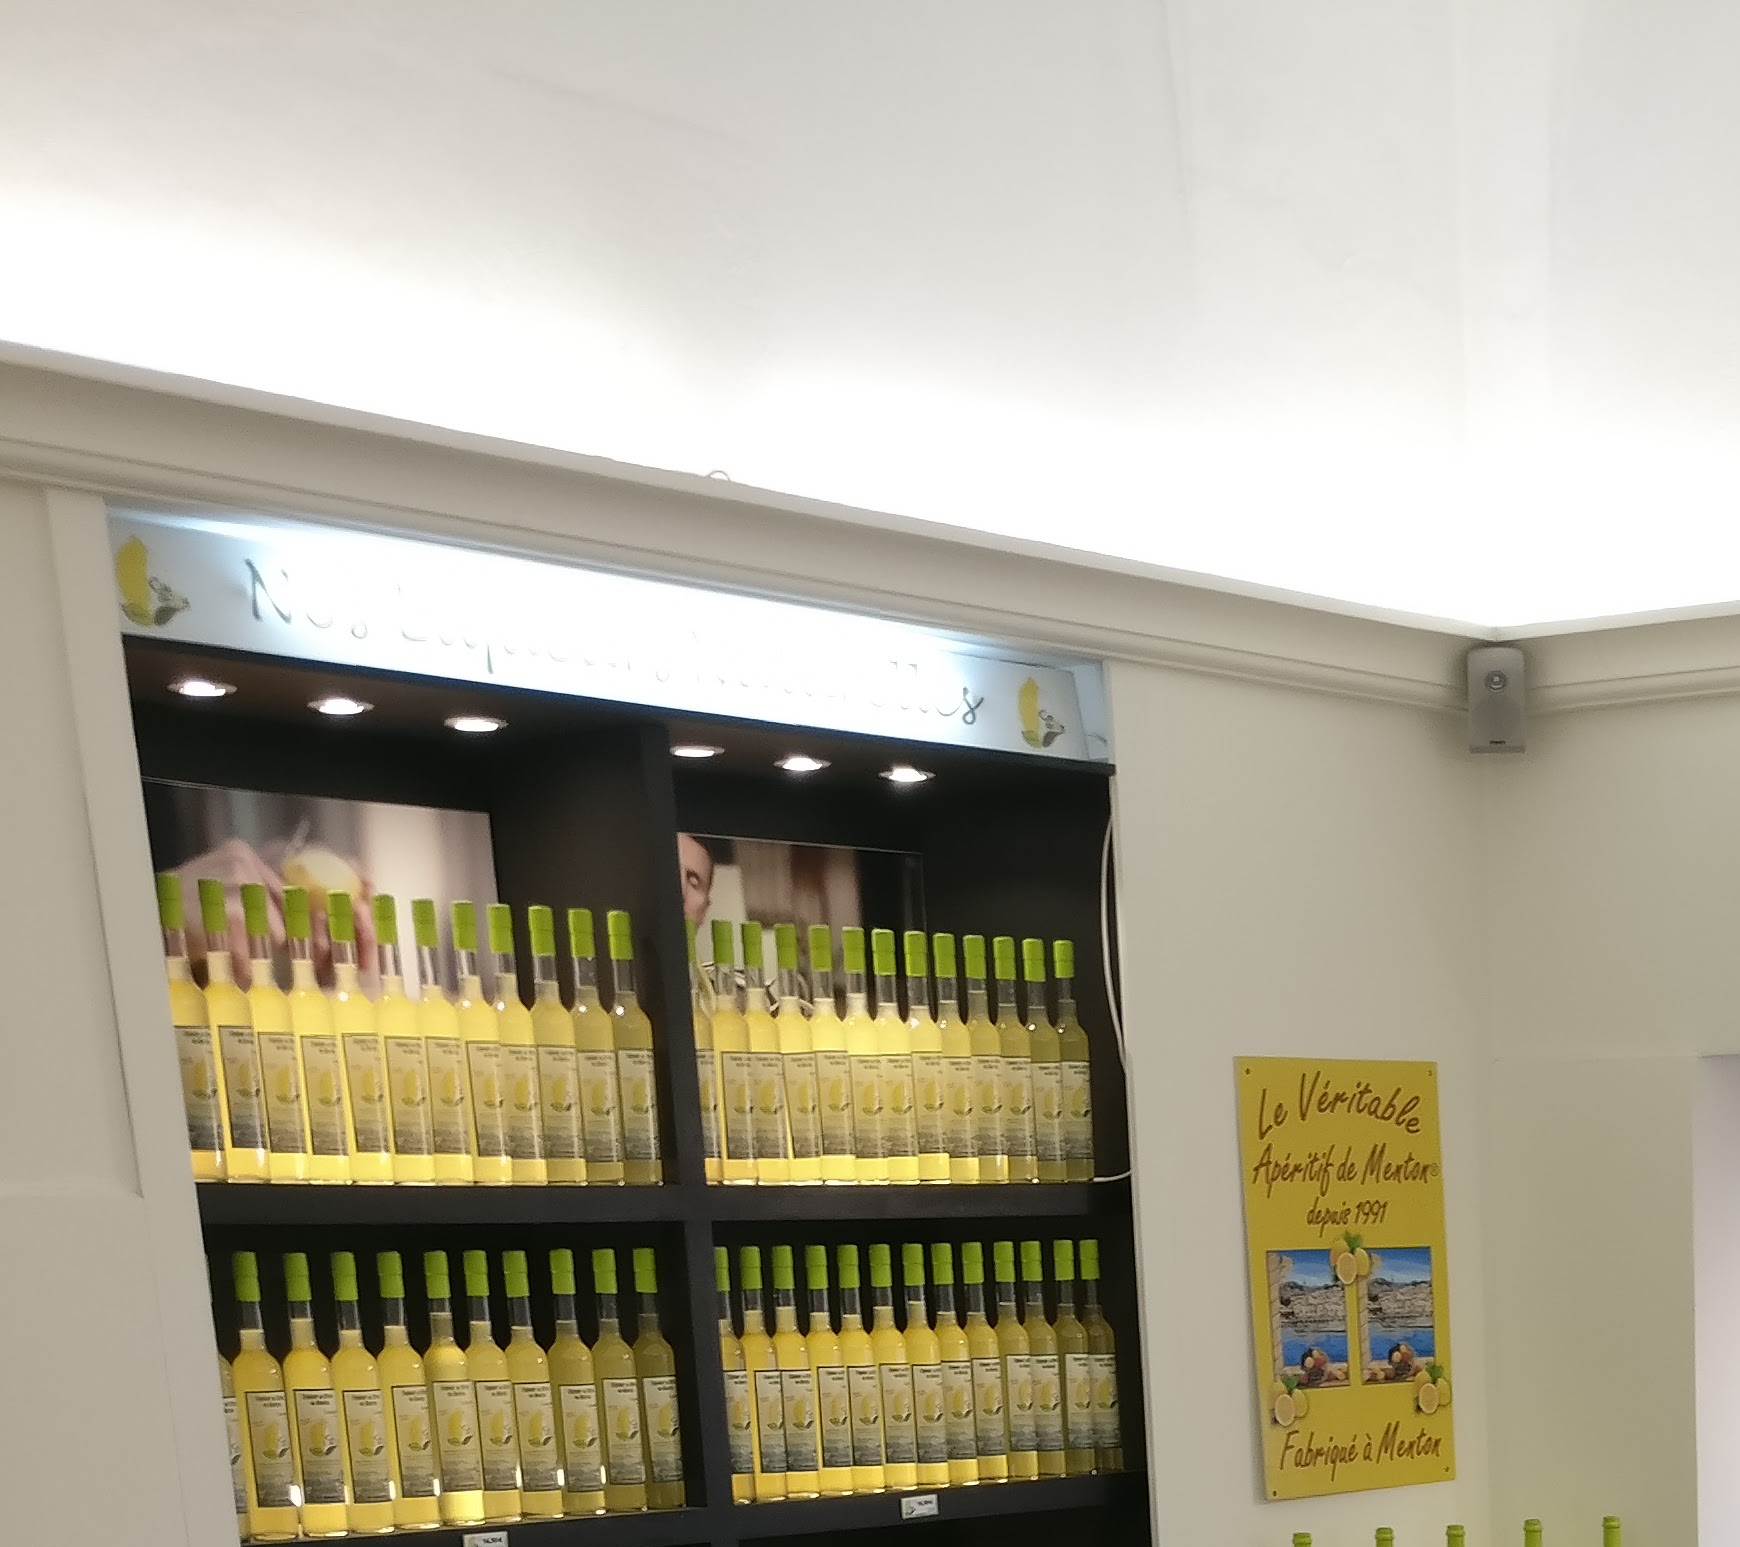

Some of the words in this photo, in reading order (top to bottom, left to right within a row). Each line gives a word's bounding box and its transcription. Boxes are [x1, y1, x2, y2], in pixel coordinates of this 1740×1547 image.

[1258, 1088, 1288, 1140] Le
[1299, 1071, 1422, 1135] Véritable
[1252, 1143, 1332, 1198] Apéritif
[1337, 1154, 1358, 1183] de
[1306, 1197, 1350, 1237] depuis
[1354, 1200, 1388, 1225] 1991
[1280, 1430, 1358, 1481] Fabriqué
[1363, 1434, 1373, 1460] à
[1376, 1422, 1442, 1463] Menton
